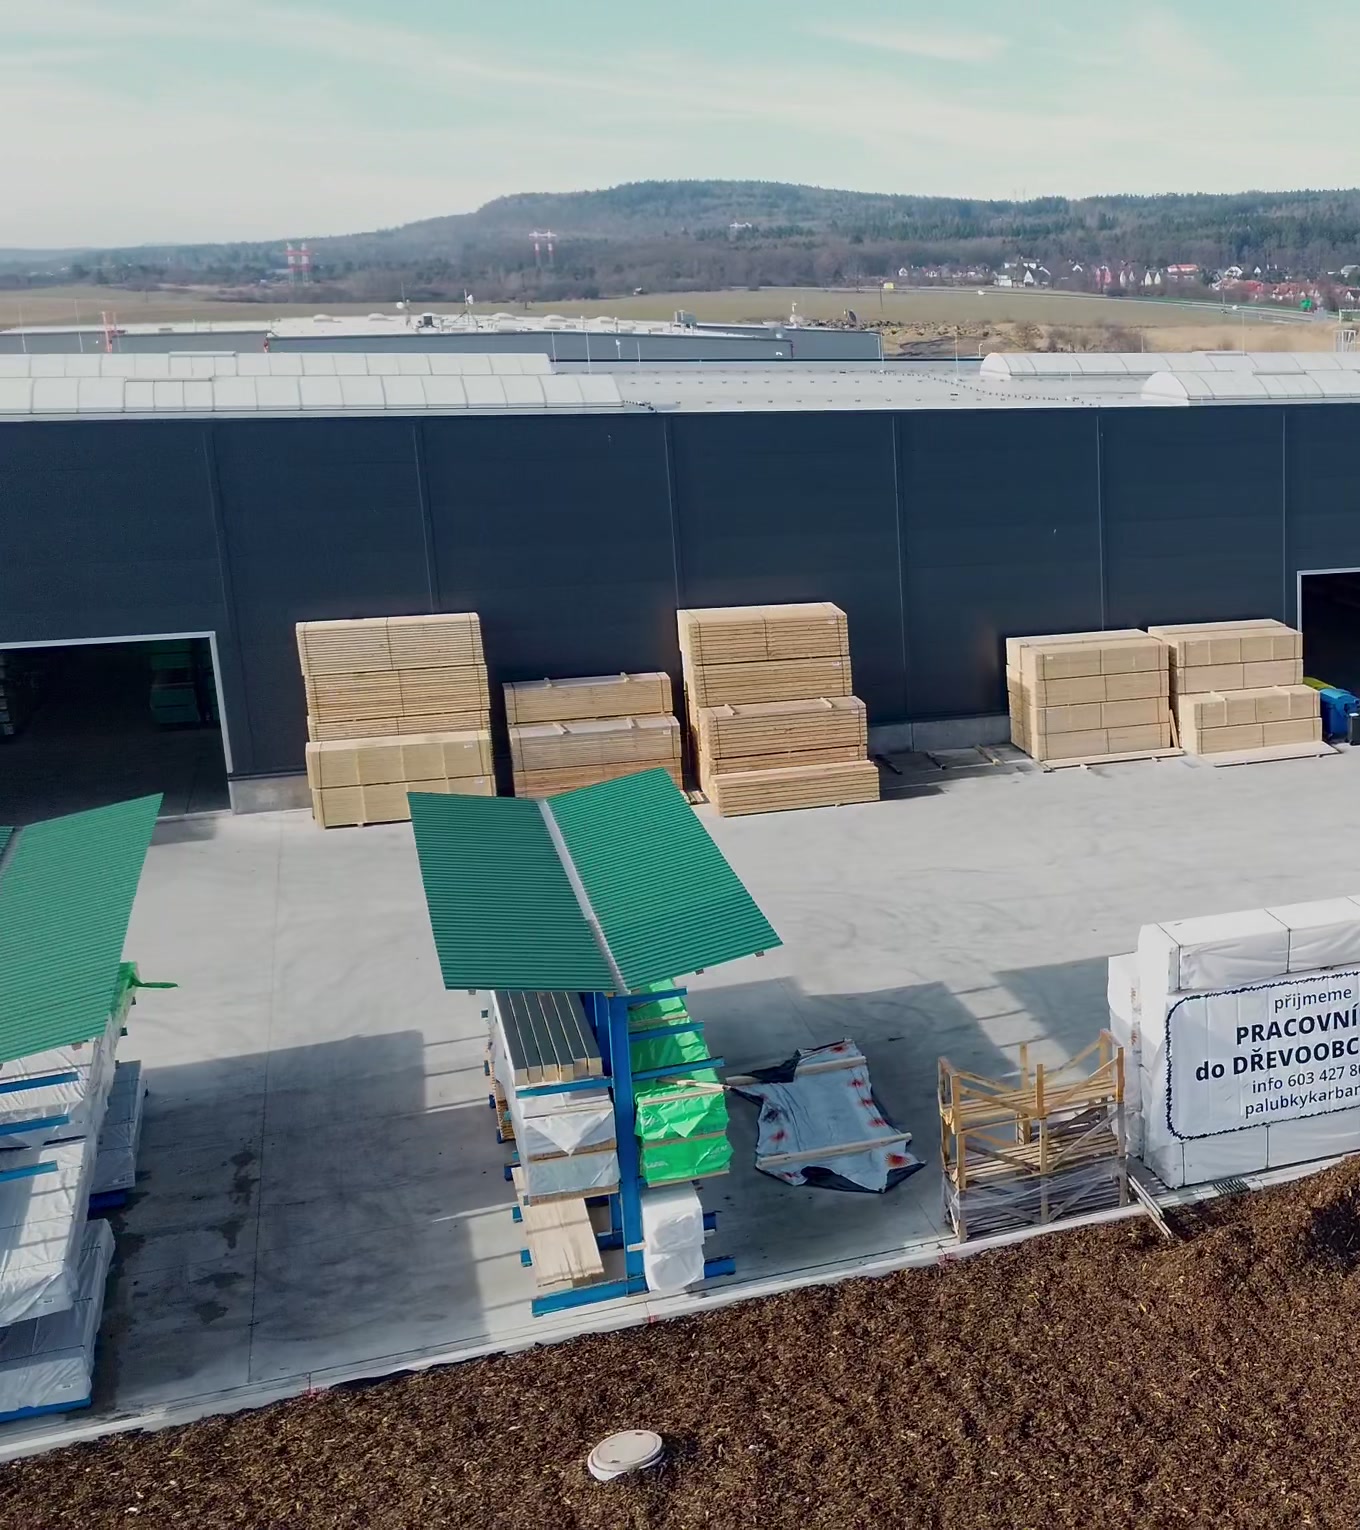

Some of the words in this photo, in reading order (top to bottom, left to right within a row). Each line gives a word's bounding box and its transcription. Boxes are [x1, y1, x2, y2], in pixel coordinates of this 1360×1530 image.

[1274, 987, 1352, 1013] přijmeme
[1195, 1061, 1225, 1082] do
[1252, 1073, 1283, 1094] info
[1287, 1071, 1315, 1087] 603
[1319, 1066, 1344, 1082] 427
